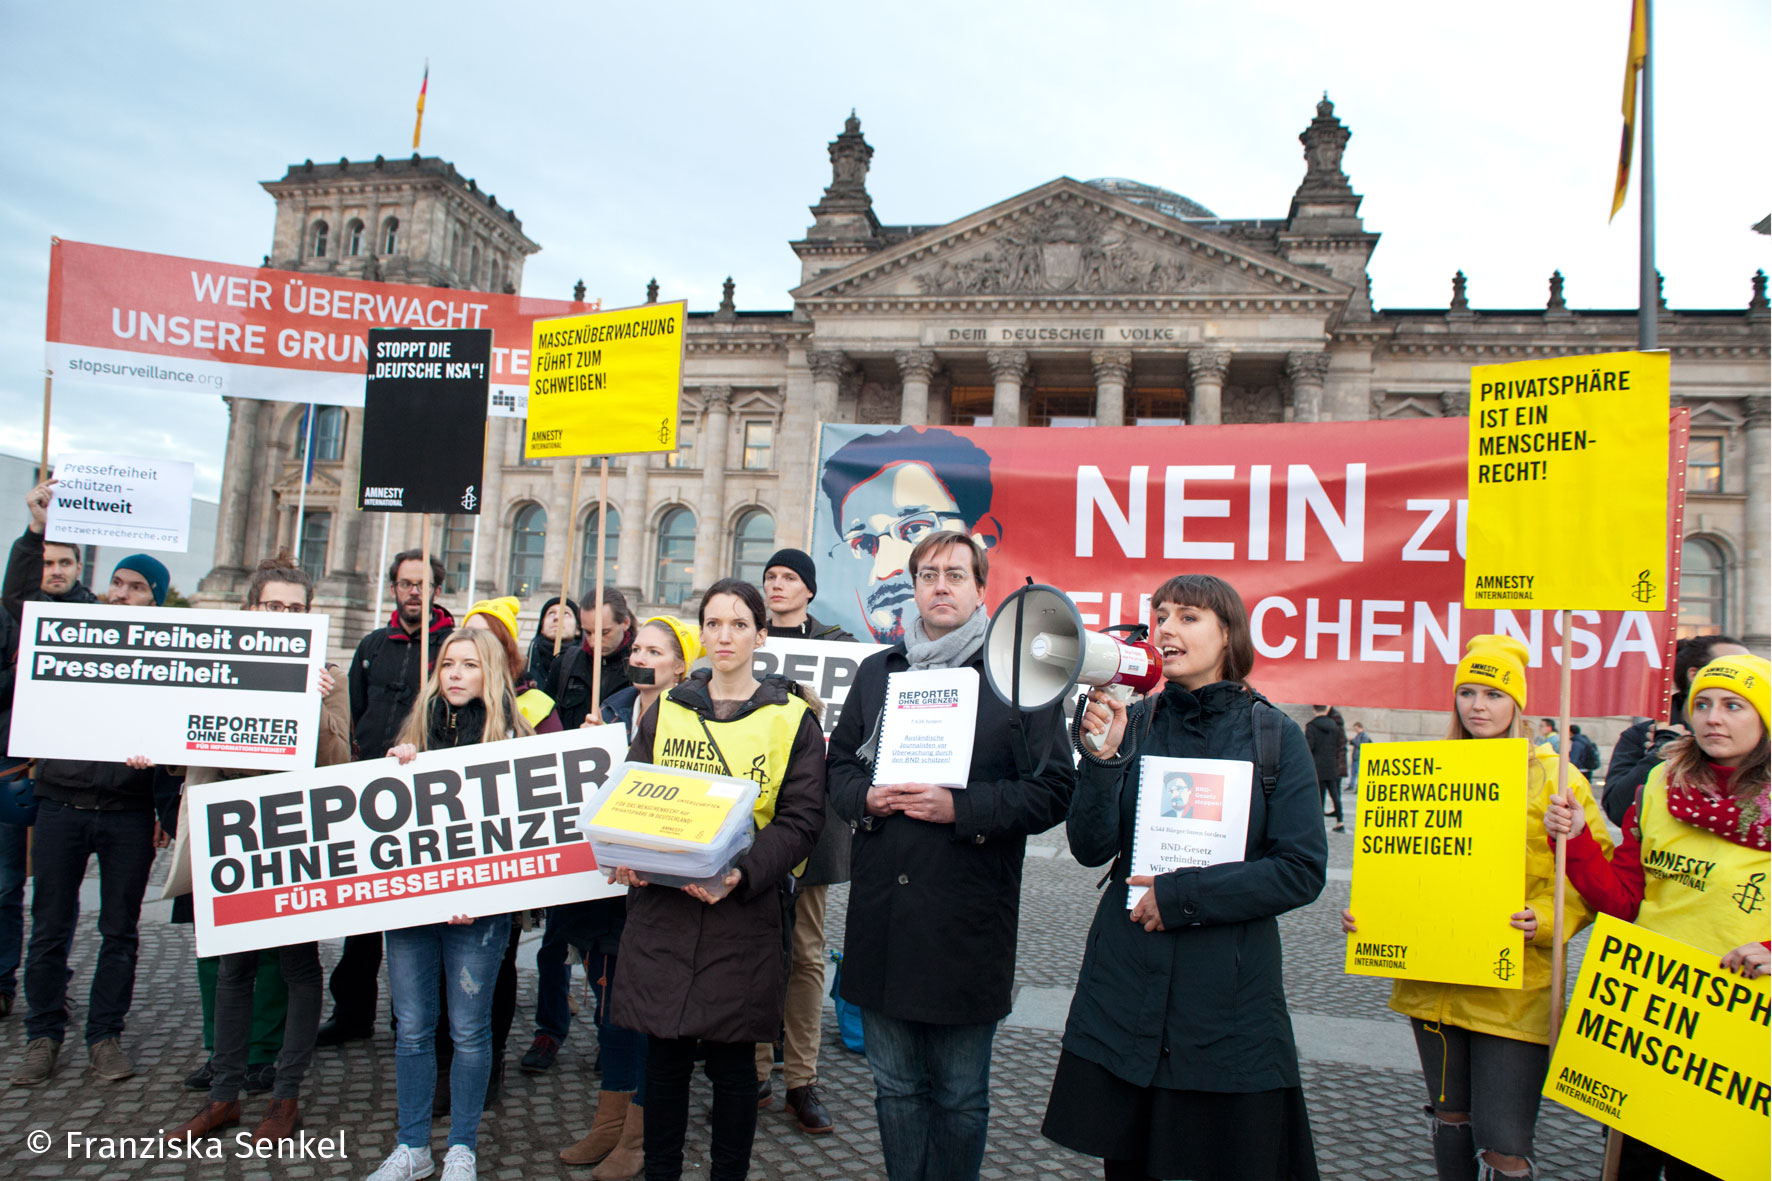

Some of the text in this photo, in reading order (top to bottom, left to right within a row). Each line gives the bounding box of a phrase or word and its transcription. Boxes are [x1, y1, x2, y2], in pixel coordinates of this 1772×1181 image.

[191, 271, 488, 329] WER ÜBERWACHT
[112, 307, 266, 354] UNSERE
[538, 317, 675, 350] MASSENÜBERWACHUNG
[948, 328, 1174, 340] DEM DEUTSCHEN VOLKE
[377, 342, 451, 358] STOPPT DIE
[537, 350, 601, 373] FÜHRT ZUM
[69, 359, 223, 389] stopsurveillance.org
[535, 372, 607, 395] SCHWEIGEN!
[1480, 369, 1631, 402] PRIVATSPHÄRE
[1480, 405, 1548, 428] IST EIN
[531, 429, 563, 442] AMNESTY
[1479, 430, 1597, 456] MENSCHEN-
[64, 463, 158, 481] Pressefreiheit
[1478, 461, 1548, 483] RECHT!
[59, 478, 122, 493] schützen
[364, 487, 404, 499] AMNESTY
[58, 497, 133, 514] weltweit
[1075, 463, 1367, 562] NEIN
[55, 524, 179, 543] netzwerkrecherche.org
[1475, 576, 1534, 589] AMNESTY
[1475, 591, 1534, 600] INTERNATIONAL
[40, 620, 307, 654] Keine Freiheit ohne
[1494, 609, 1663, 670] NSA
[36, 655, 239, 685] Pressefreiheit.
[899, 689, 958, 700] REPORTER
[188, 714, 298, 734] REPORTER
[187, 730, 297, 746] OHNE GRENZEN
[662, 738, 721, 762] AMNES
[1367, 757, 1442, 776] MASSEN-
[207, 746, 611, 857] REPORTER
[626, 781, 680, 800] 7000
[1366, 781, 1500, 802] ÜBERWACHUNG
[1364, 806, 1463, 828] FÜHRT ZUM
[210, 807, 584, 894] OHNE GRENZE
[1161, 842, 1212, 855] BND-Gesetz
[1362, 835, 1473, 856] SCHWEIGEN!
[275, 852, 561, 913] FÜR PRESSEFREIHEIT
[1355, 942, 1408, 959] AMNESTY
[1354, 957, 1407, 970] INTERNATIONAL
[1589, 972, 1700, 1040] IST EIN
[1558, 1066, 1628, 1107] AMNESTY
[1555, 1081, 1622, 1120] INTERNATIONAL
